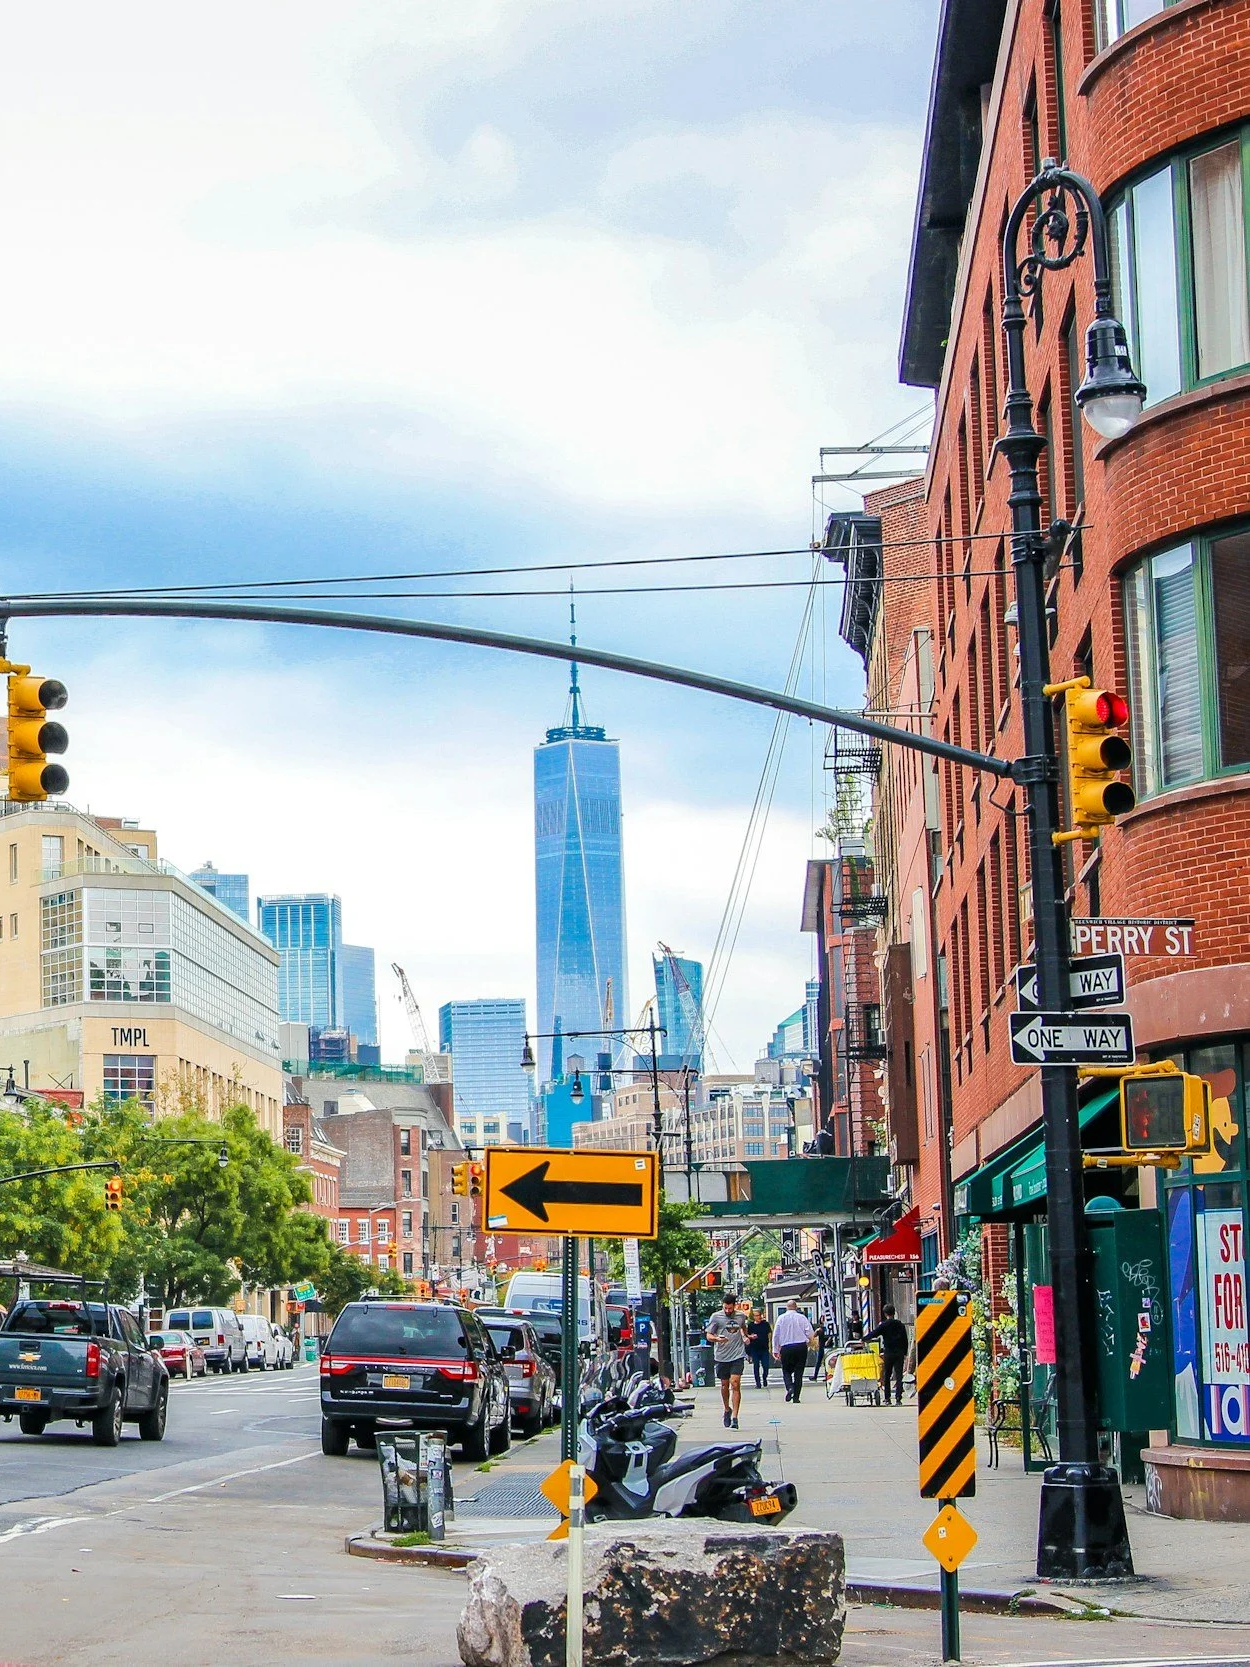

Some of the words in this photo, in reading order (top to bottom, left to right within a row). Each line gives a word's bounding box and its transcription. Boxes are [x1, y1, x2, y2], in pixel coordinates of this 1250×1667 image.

[1075, 926, 1154, 955] PERRY
[1165, 926, 1193, 956] ST
[1080, 970, 1114, 993] WAY
[111, 1027, 150, 1047] TMPL
[1027, 1029, 1063, 1048] ONE
[1083, 1029, 1122, 1048] WAY
[1219, 1223, 1245, 1263] ST
[1214, 1272, 1244, 1330] FOR
[639, 1323, 646, 1332] P
